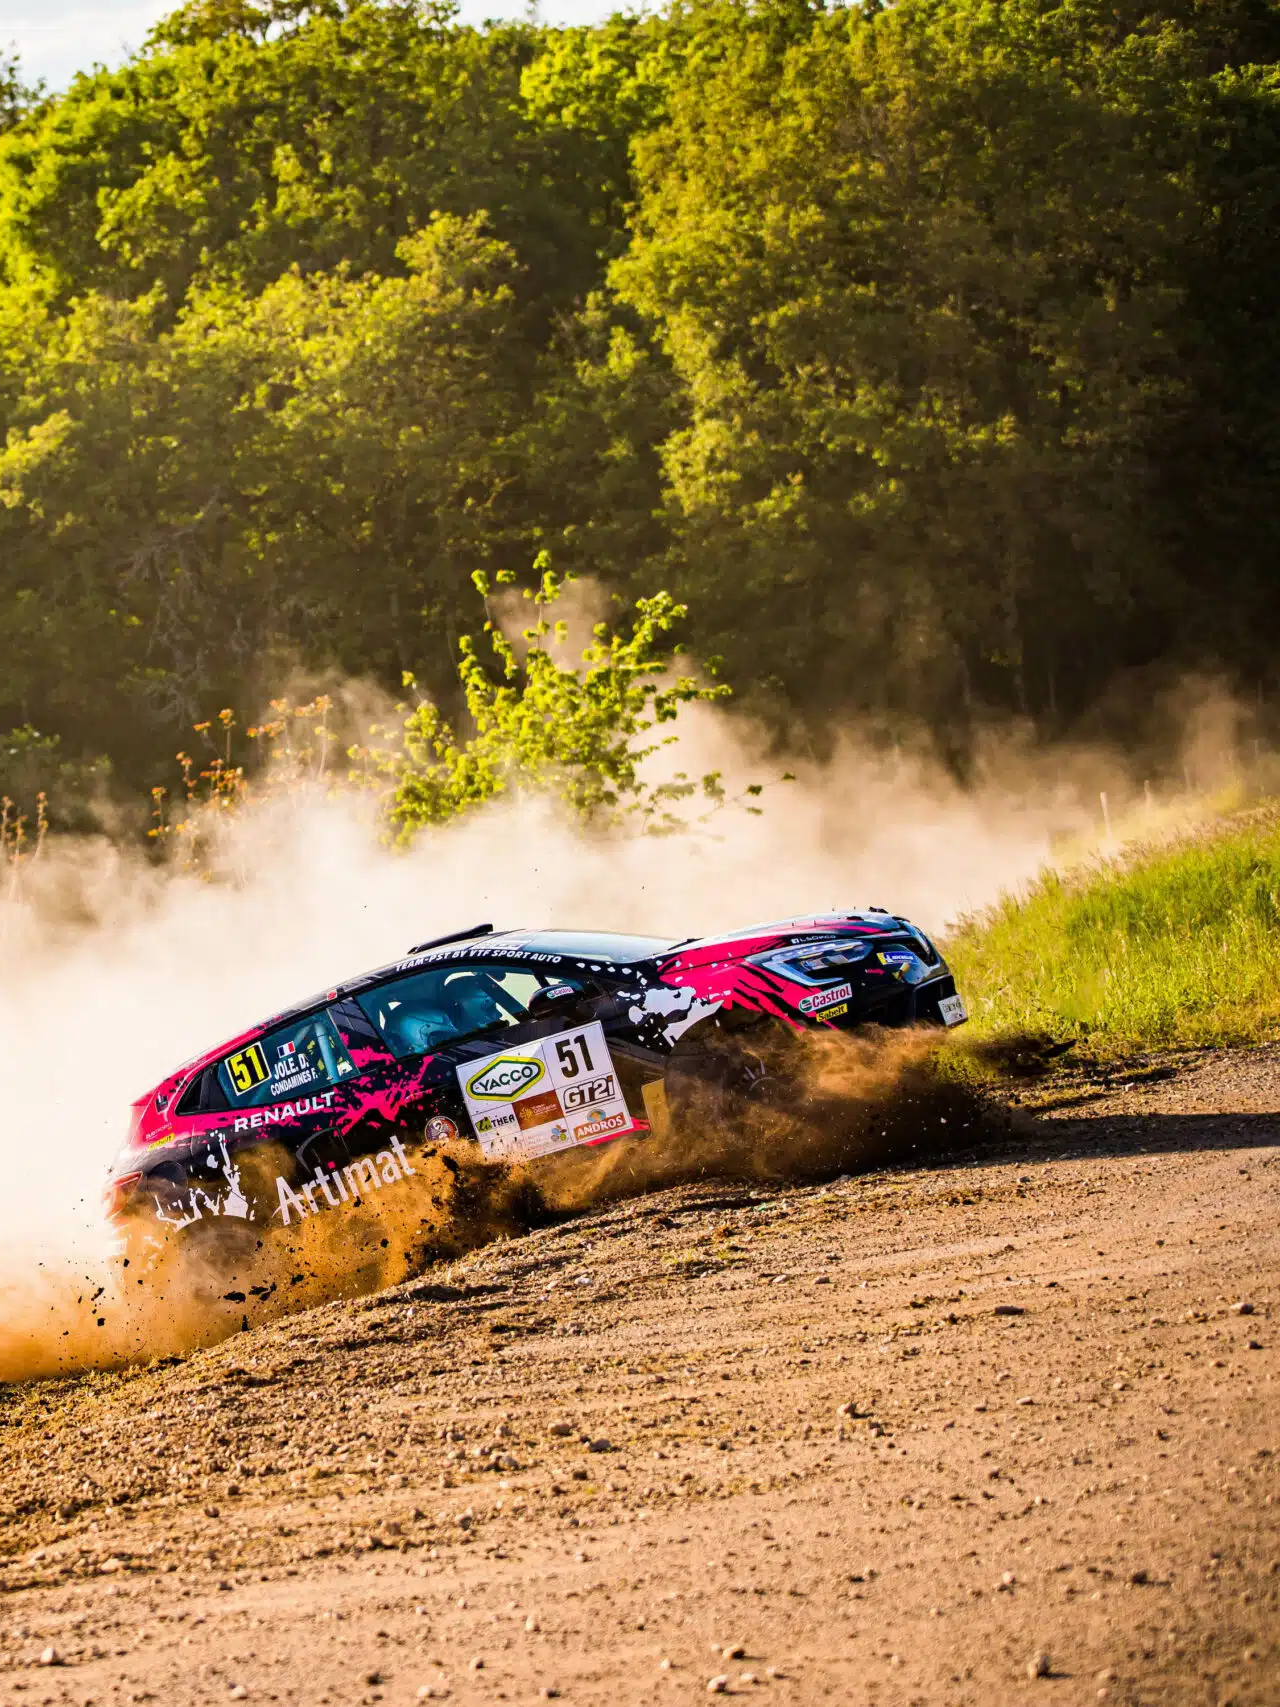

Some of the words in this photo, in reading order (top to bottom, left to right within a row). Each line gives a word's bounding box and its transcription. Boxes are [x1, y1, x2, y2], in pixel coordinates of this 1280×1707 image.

[451, 949, 468, 959] BY
[470, 949, 491, 958] VTF
[491, 949, 529, 959] SPORT
[531, 952, 562, 964] AUTO
[812, 984, 851, 1008] Castrol
[817, 1005, 846, 1021] Sabelt
[229, 1046, 266, 1091] 51
[555, 1034, 595, 1079] 51
[270, 1068, 312, 1097] CONDAMINES
[311, 1067, 319, 1080] F.
[479, 1065, 534, 1092] YACCO
[562, 1075, 616, 1111] GT2i
[234, 1091, 336, 1133] RENAULT
[576, 1115, 624, 1138] ANDROS
[272, 1135, 417, 1226] Artimat
